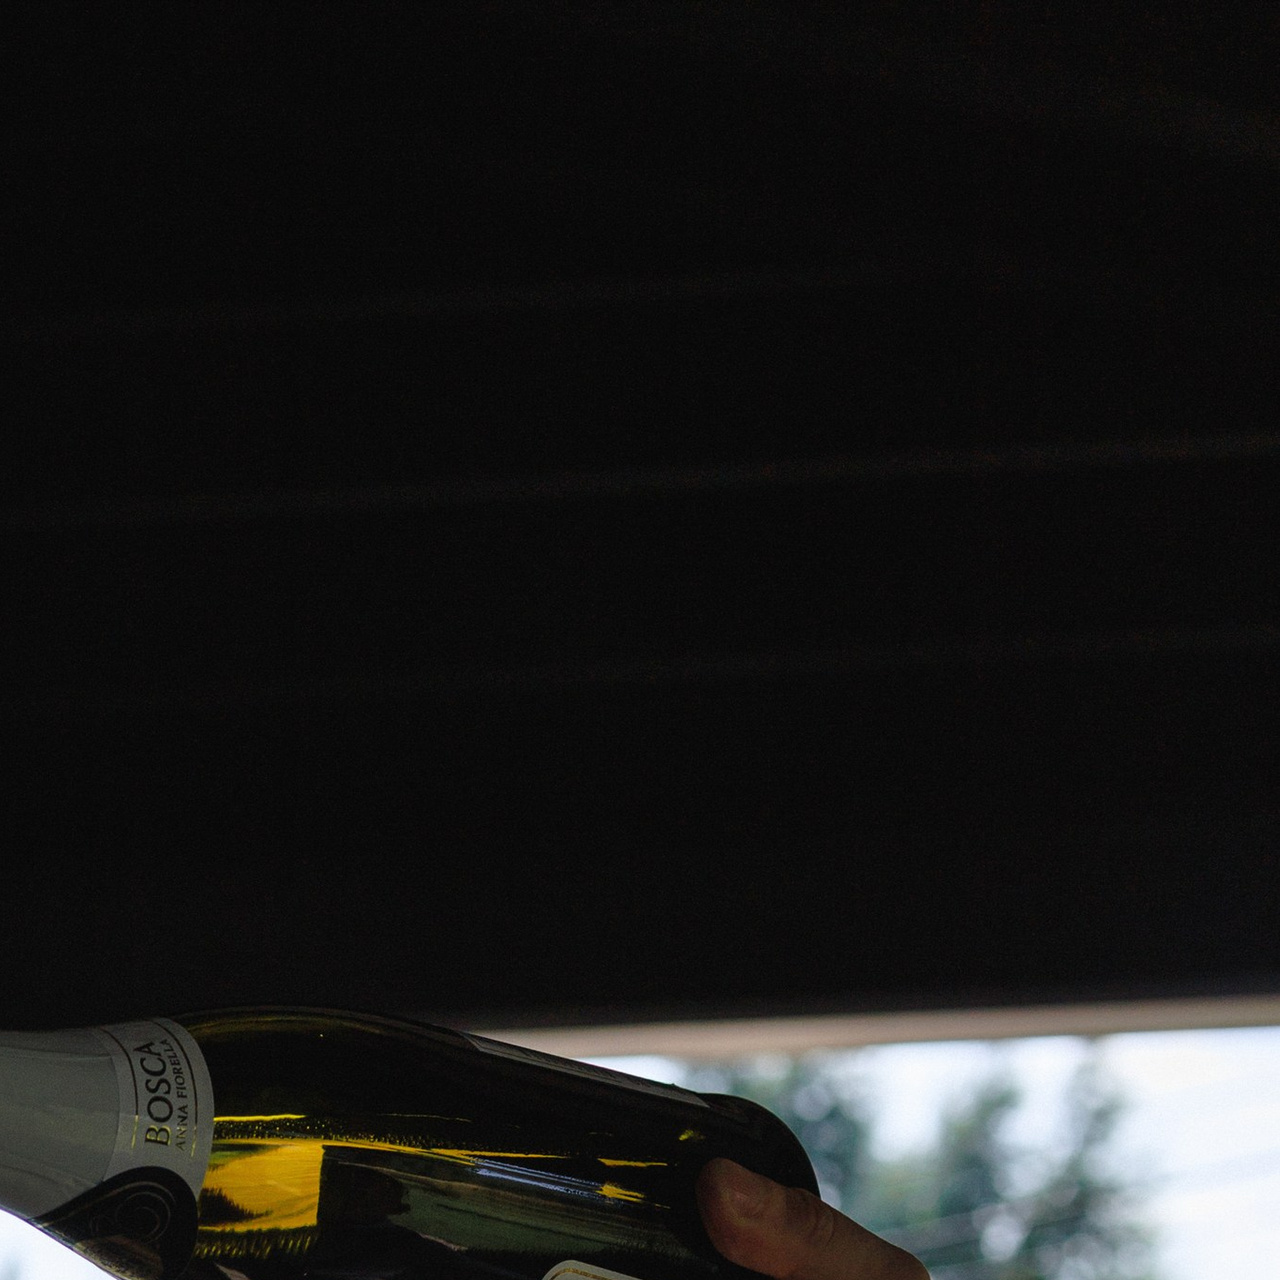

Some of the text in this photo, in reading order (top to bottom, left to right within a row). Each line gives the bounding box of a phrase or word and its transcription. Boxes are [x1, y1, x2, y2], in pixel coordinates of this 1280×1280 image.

[134, 1042, 172, 1146] BOSCA
[160, 1040, 188, 1151] ANNA FIORELLA
